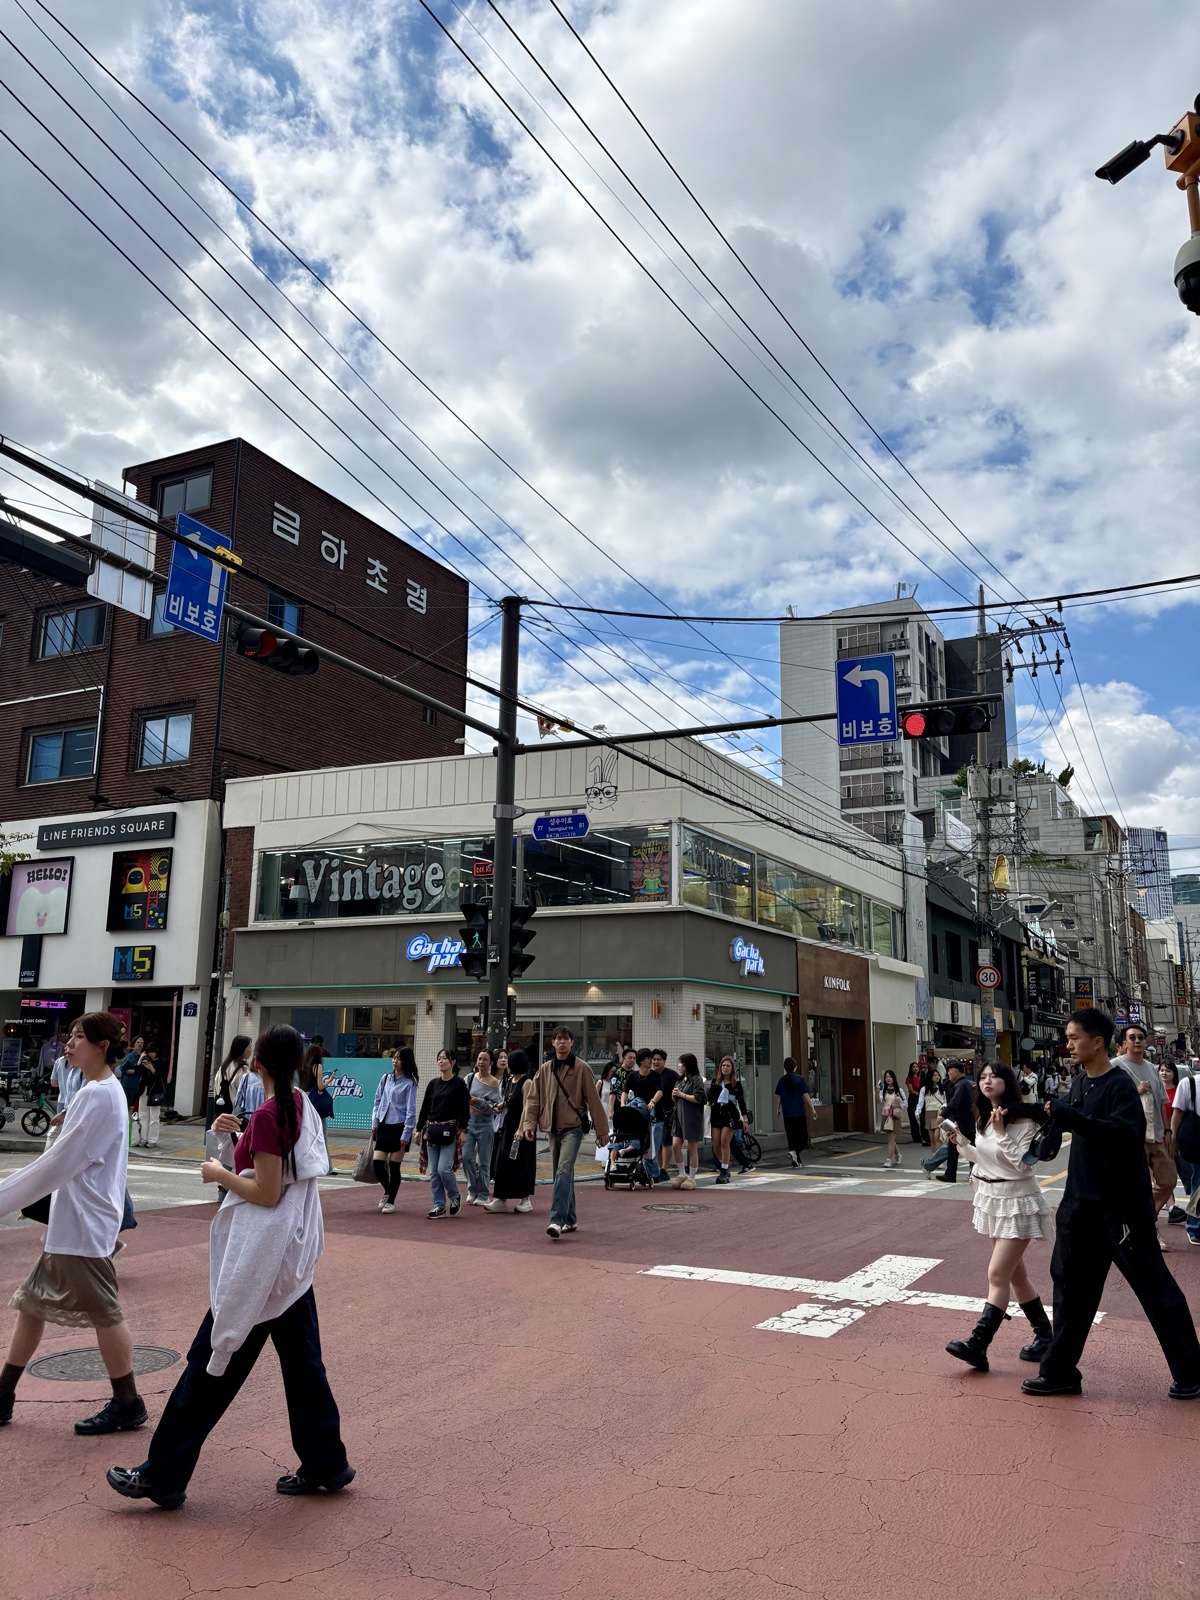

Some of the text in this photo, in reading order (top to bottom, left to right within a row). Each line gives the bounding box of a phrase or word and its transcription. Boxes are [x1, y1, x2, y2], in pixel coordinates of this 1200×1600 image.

[168, 593, 217, 635] 비보호
[842, 717, 894, 740] 비보호
[43, 819, 166, 842] LINE FRIENDS SQUARE
[549, 816, 573, 826] 성수이로
[26, 867, 68, 884] HELLO!
[302, 857, 445, 910] Vintage
[407, 935, 463, 957] Gacha
[733, 940, 760, 960] Gacha
[112, 946, 152, 973] M5
[426, 948, 467, 973] par
[823, 975, 851, 992] KINFOLK
[981, 971, 996, 983] 30
[1028, 971, 1037, 997] LUSH
[1078, 983, 1091, 992] 24
